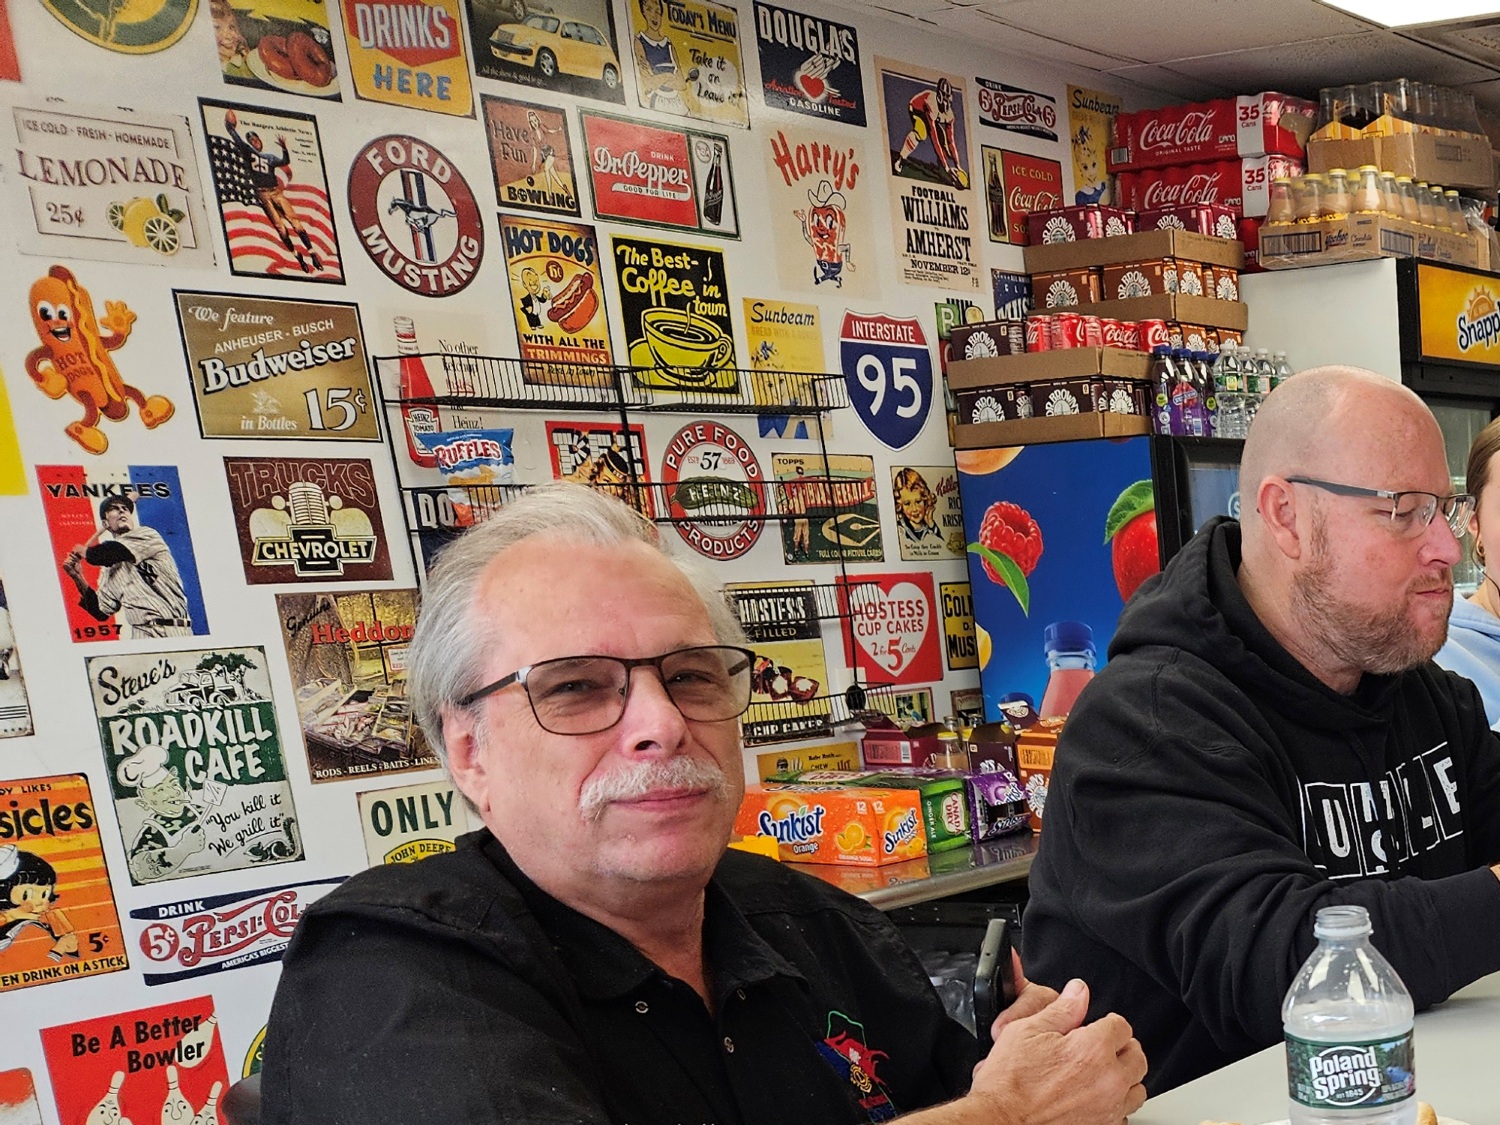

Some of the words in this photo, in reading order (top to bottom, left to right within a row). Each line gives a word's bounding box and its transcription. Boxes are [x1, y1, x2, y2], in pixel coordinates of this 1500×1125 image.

[356, 2, 452, 50] DRINKS
[665, 0, 706, 30] TODAY'S
[707, 14, 737, 39] MENU
[758, 5, 856, 64] DOUGLAS
[688, 48, 714, 70] Take
[715, 55, 726, 71] it
[373, 64, 453, 100] HERE
[697, 82, 726, 103] Leave
[789, 97, 841, 117] GASOLINE
[1239, 105, 1260, 121] 35
[493, 119, 529, 143] Have
[1140, 109, 1216, 150] Coca-Cola
[1241, 120, 1257, 129] Cans
[115, 133, 171, 150] HOMEMADE
[500, 141, 528, 165] Fun
[1155, 148, 1182, 157] ORIGINAL
[1183, 145, 1201, 154] TASTE
[251, 153, 270, 174] 25
[366, 139, 452, 185] FORD
[650, 151, 675, 162] DRINK
[769, 130, 860, 191] Harry's
[16, 149, 190, 192] LEMONADE
[1011, 164, 1026, 176] ICE
[1029, 168, 1053, 182] COLD
[1245, 168, 1265, 185] 35
[507, 184, 576, 210] BOWLING
[622, 183, 643, 195] GOOD
[661, 189, 676, 200] LIFE
[911, 185, 956, 203] FOOTBALL
[1144, 171, 1222, 210] Coca-Cola
[1247, 184, 1262, 192] Cans
[46, 200, 85, 227] 25¢
[901, 196, 969, 231] WILLIAMS
[505, 226, 545, 260] HOT
[548, 231, 595, 267] DOGS
[616, 244, 649, 267] The
[906, 228, 971, 262] AMHERST
[361, 225, 480, 294] MUSTANG
[911, 259, 959, 275] NOVEMBER
[622, 268, 696, 307] Coffee
[702, 283, 721, 298] in
[188, 305, 219, 323] We
[219, 308, 274, 332] feature
[693, 295, 728, 318] town
[750, 302, 815, 326] Sunbeam
[214, 331, 283, 355] ANHEUSER
[293, 318, 334, 338] BUSCH
[523, 333, 554, 346] WITH
[558, 336, 580, 347] ALL
[584, 338, 605, 350] THE
[851, 319, 916, 343] INTERSTATE
[438, 339, 454, 354] No
[454, 341, 479, 355] other
[526, 348, 608, 365] TRIMMINGS
[55, 352, 86, 369] HOT
[200, 337, 357, 395] Budweiser
[856, 353, 922, 419] 95
[303, 387, 367, 432] 15¢
[240, 416, 254, 430] in
[256, 416, 297, 431] Bottles
[452, 415, 484, 430] Heinz!
[433, 440, 502, 469] RUFFLES
[666, 425, 707, 470] PURE
[712, 426, 759, 478] FOOD
[700, 451, 722, 471] 57
[777, 458, 805, 467] TOPPS
[45, 482, 171, 499] YANKEES
[228, 461, 376, 508] TRUCKS
[679, 519, 760, 557] PRODUCTS
[261, 541, 368, 560] CHEVROLET
[853, 599, 925, 622] HOSTESS
[74, 625, 123, 639] 1957
[312, 620, 415, 646] Heddon
[754, 627, 797, 640] FILLED
[857, 622, 882, 637] CUP
[887, 619, 924, 635] CAKES
[871, 642, 879, 656] 2
[887, 636, 904, 671] 5
[97, 657, 177, 706] Steve's
[110, 707, 272, 756] ROADKILL
[185, 743, 266, 784] CAFE
[315, 768, 342, 778] RODS
[348, 763, 377, 775] REELS
[384, 759, 410, 771] BAITS
[21, 783, 52, 795] LIKES
[243, 797, 267, 815] kill
[270, 793, 282, 807] it
[370, 791, 454, 837] ONLY
[857, 801, 867, 812] 12
[873, 801, 884, 812] 12
[945, 803, 954, 827] DRY
[951, 791, 962, 836] CANADA
[208, 834, 234, 856] We
[236, 816, 267, 846] grill
[757, 805, 827, 844] Sunkist
[884, 809, 918, 853] Sunkist
[390, 845, 416, 863] JOHN
[419, 843, 451, 854] DEERE
[793, 841, 819, 854] Orange
[158, 900, 206, 919] DRINK
[221, 950, 258, 970] AMERICA'S
[259, 941, 290, 958] BIGGEST
[22, 963, 63, 983] DRINK
[64, 963, 80, 975] ON
[83, 960, 92, 972] A
[92, 955, 126, 970] STICK
[71, 1033, 100, 1057] Be
[109, 1026, 126, 1049] A
[135, 1014, 202, 1045] Better
[127, 1041, 205, 1073] Bowler
[1309, 1046, 1378, 1080] Poland
[1312, 1068, 1381, 1100] Spring
